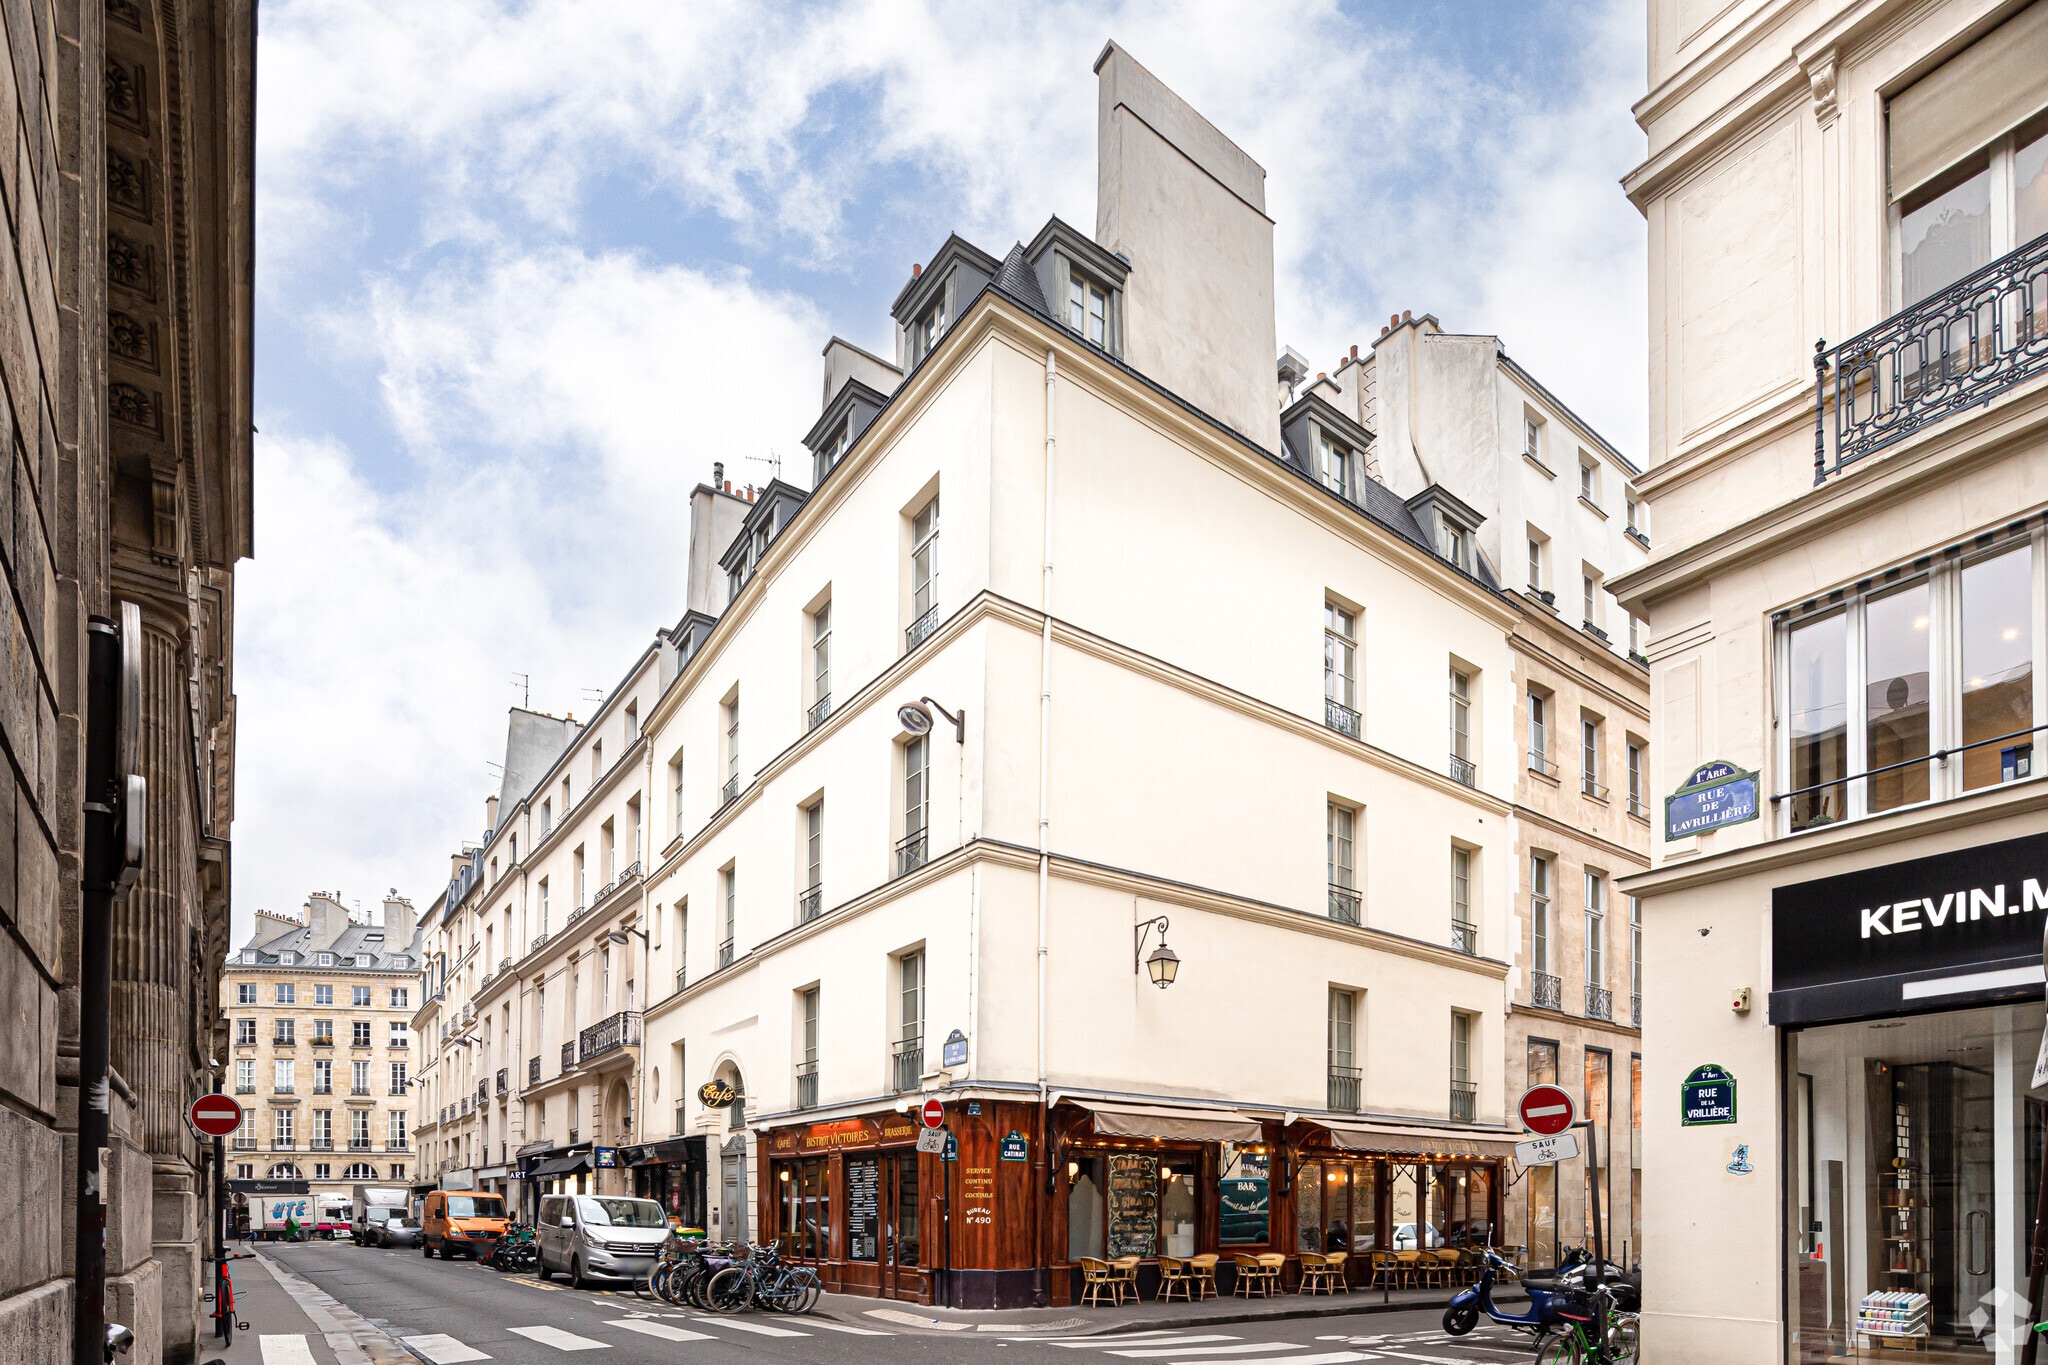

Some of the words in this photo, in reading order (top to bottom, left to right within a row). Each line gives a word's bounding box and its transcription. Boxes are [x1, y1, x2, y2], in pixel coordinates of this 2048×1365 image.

[1698, 788, 1724, 803] RUE
[1702, 801, 1719, 813] DE
[1672, 804, 1751, 833] LAVRILLIÈRE
[703, 1085, 734, 1106] Café
[1698, 1088, 1717, 1098] RUE
[1687, 1105, 1730, 1118] VRILLIÈRE
[885, 1125, 912, 1137] BRASSERIE
[806, 1136, 829, 1148] BISTROT
[829, 1130, 869, 1145] VICTOIRES
[1532, 1139, 1557, 1149] SAUF
[510, 1171, 526, 1179] ART
[1237, 1182, 1257, 1192] BAR
